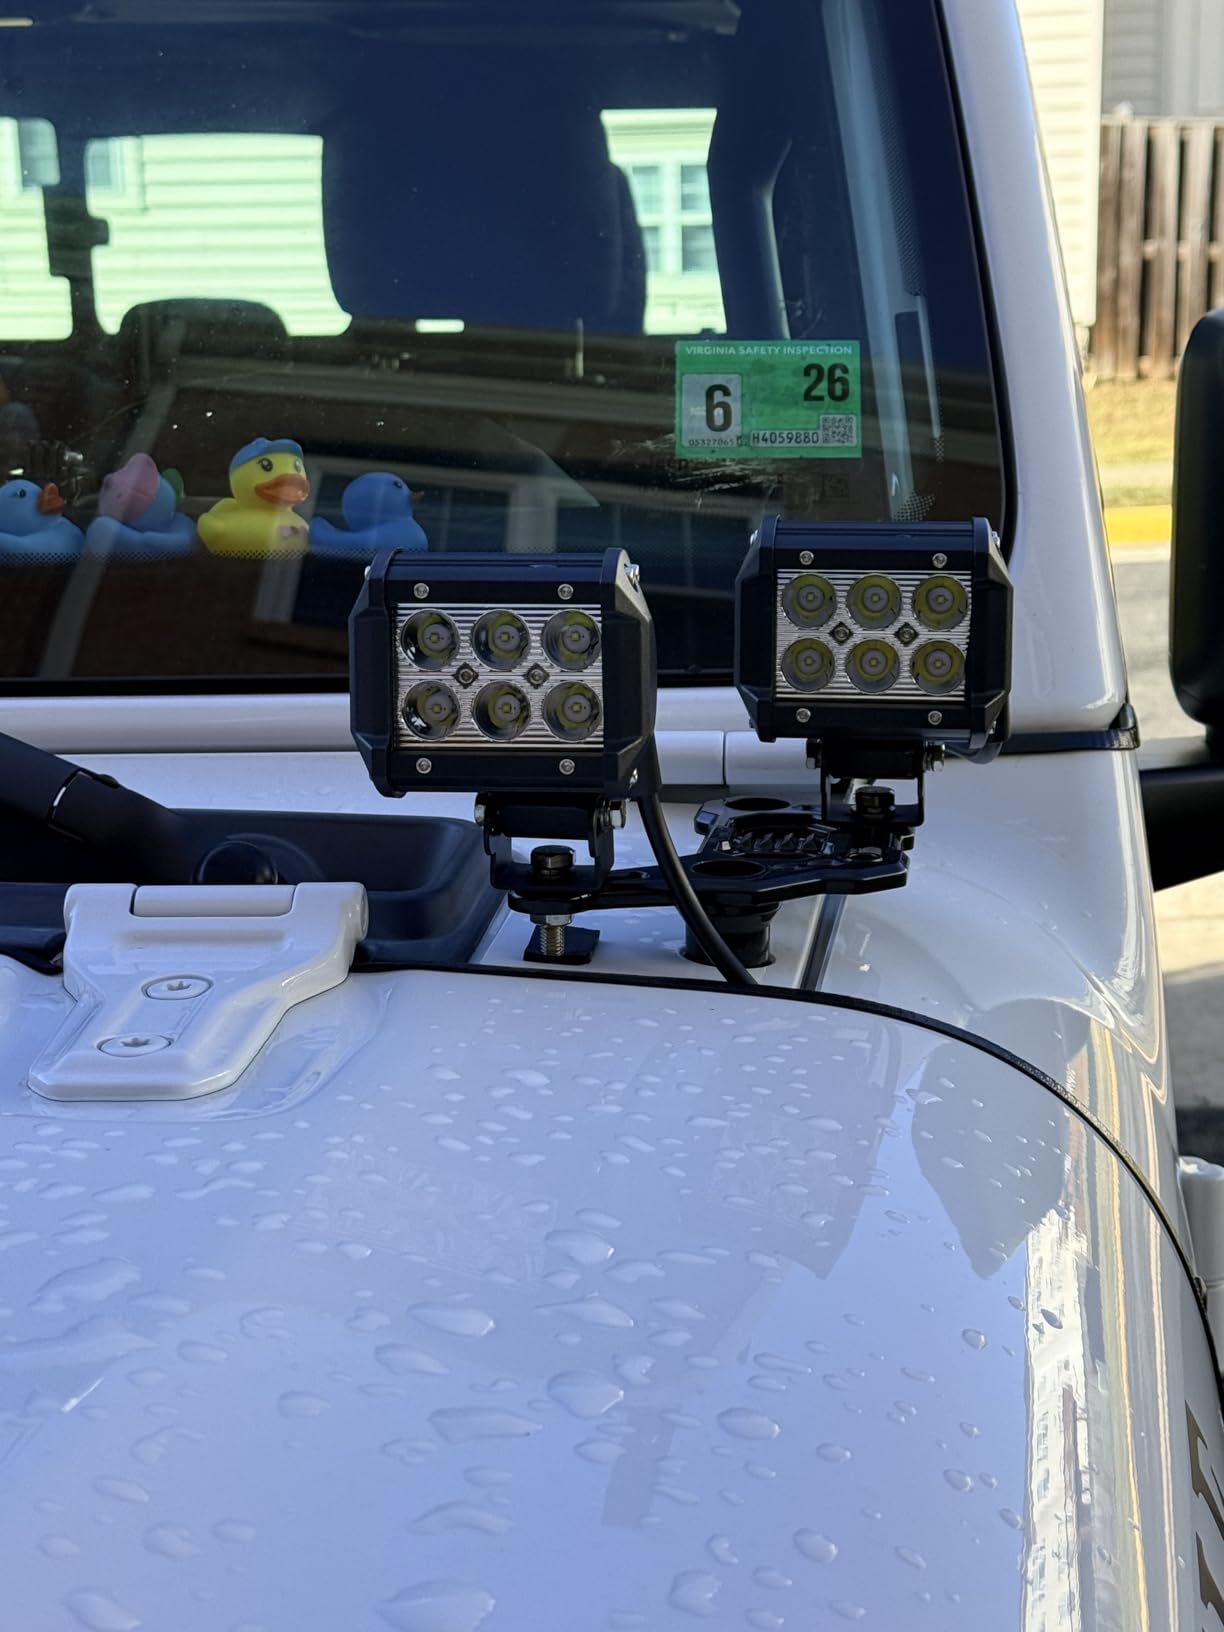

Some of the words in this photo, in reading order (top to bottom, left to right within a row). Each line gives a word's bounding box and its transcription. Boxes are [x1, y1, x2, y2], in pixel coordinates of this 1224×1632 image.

[686, 346, 736, 355] VIRGINIA
[738, 346, 781, 355] SAFETY
[783, 346, 852, 355] INSPECTION
[803, 363, 850, 402] 26
[705, 384, 732, 432] 6
[752, 432, 819, 444] H4059880
